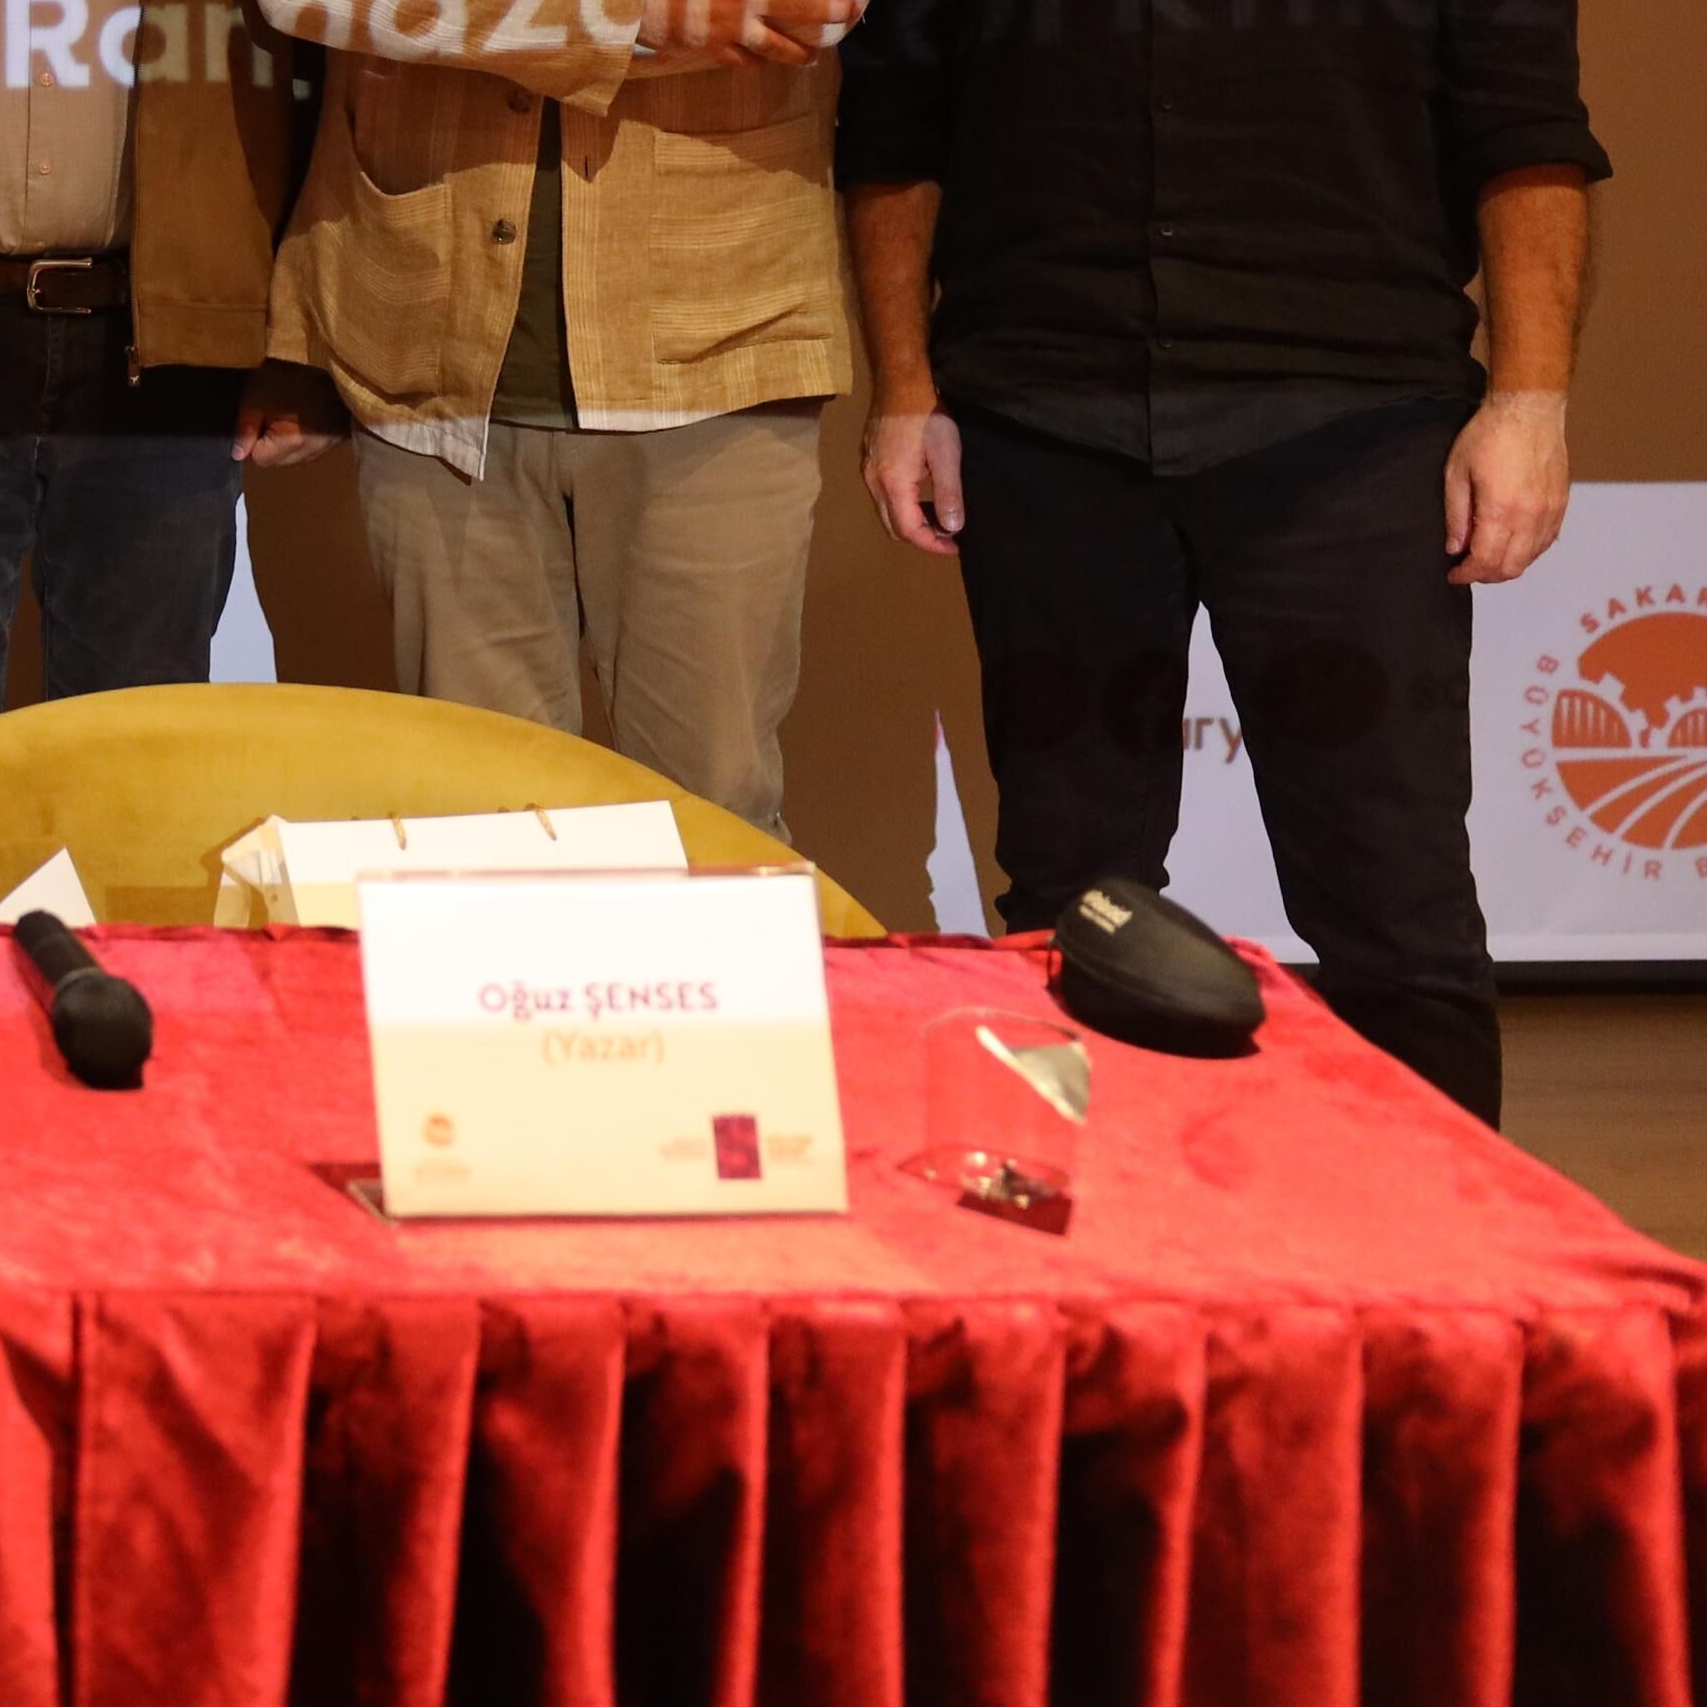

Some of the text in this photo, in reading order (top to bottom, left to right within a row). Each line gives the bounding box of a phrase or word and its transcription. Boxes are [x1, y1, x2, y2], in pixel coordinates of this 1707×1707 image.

[478, 979, 720, 1023] Oğuz ŞENSES
[541, 1029, 666, 1066] (Yazar)
